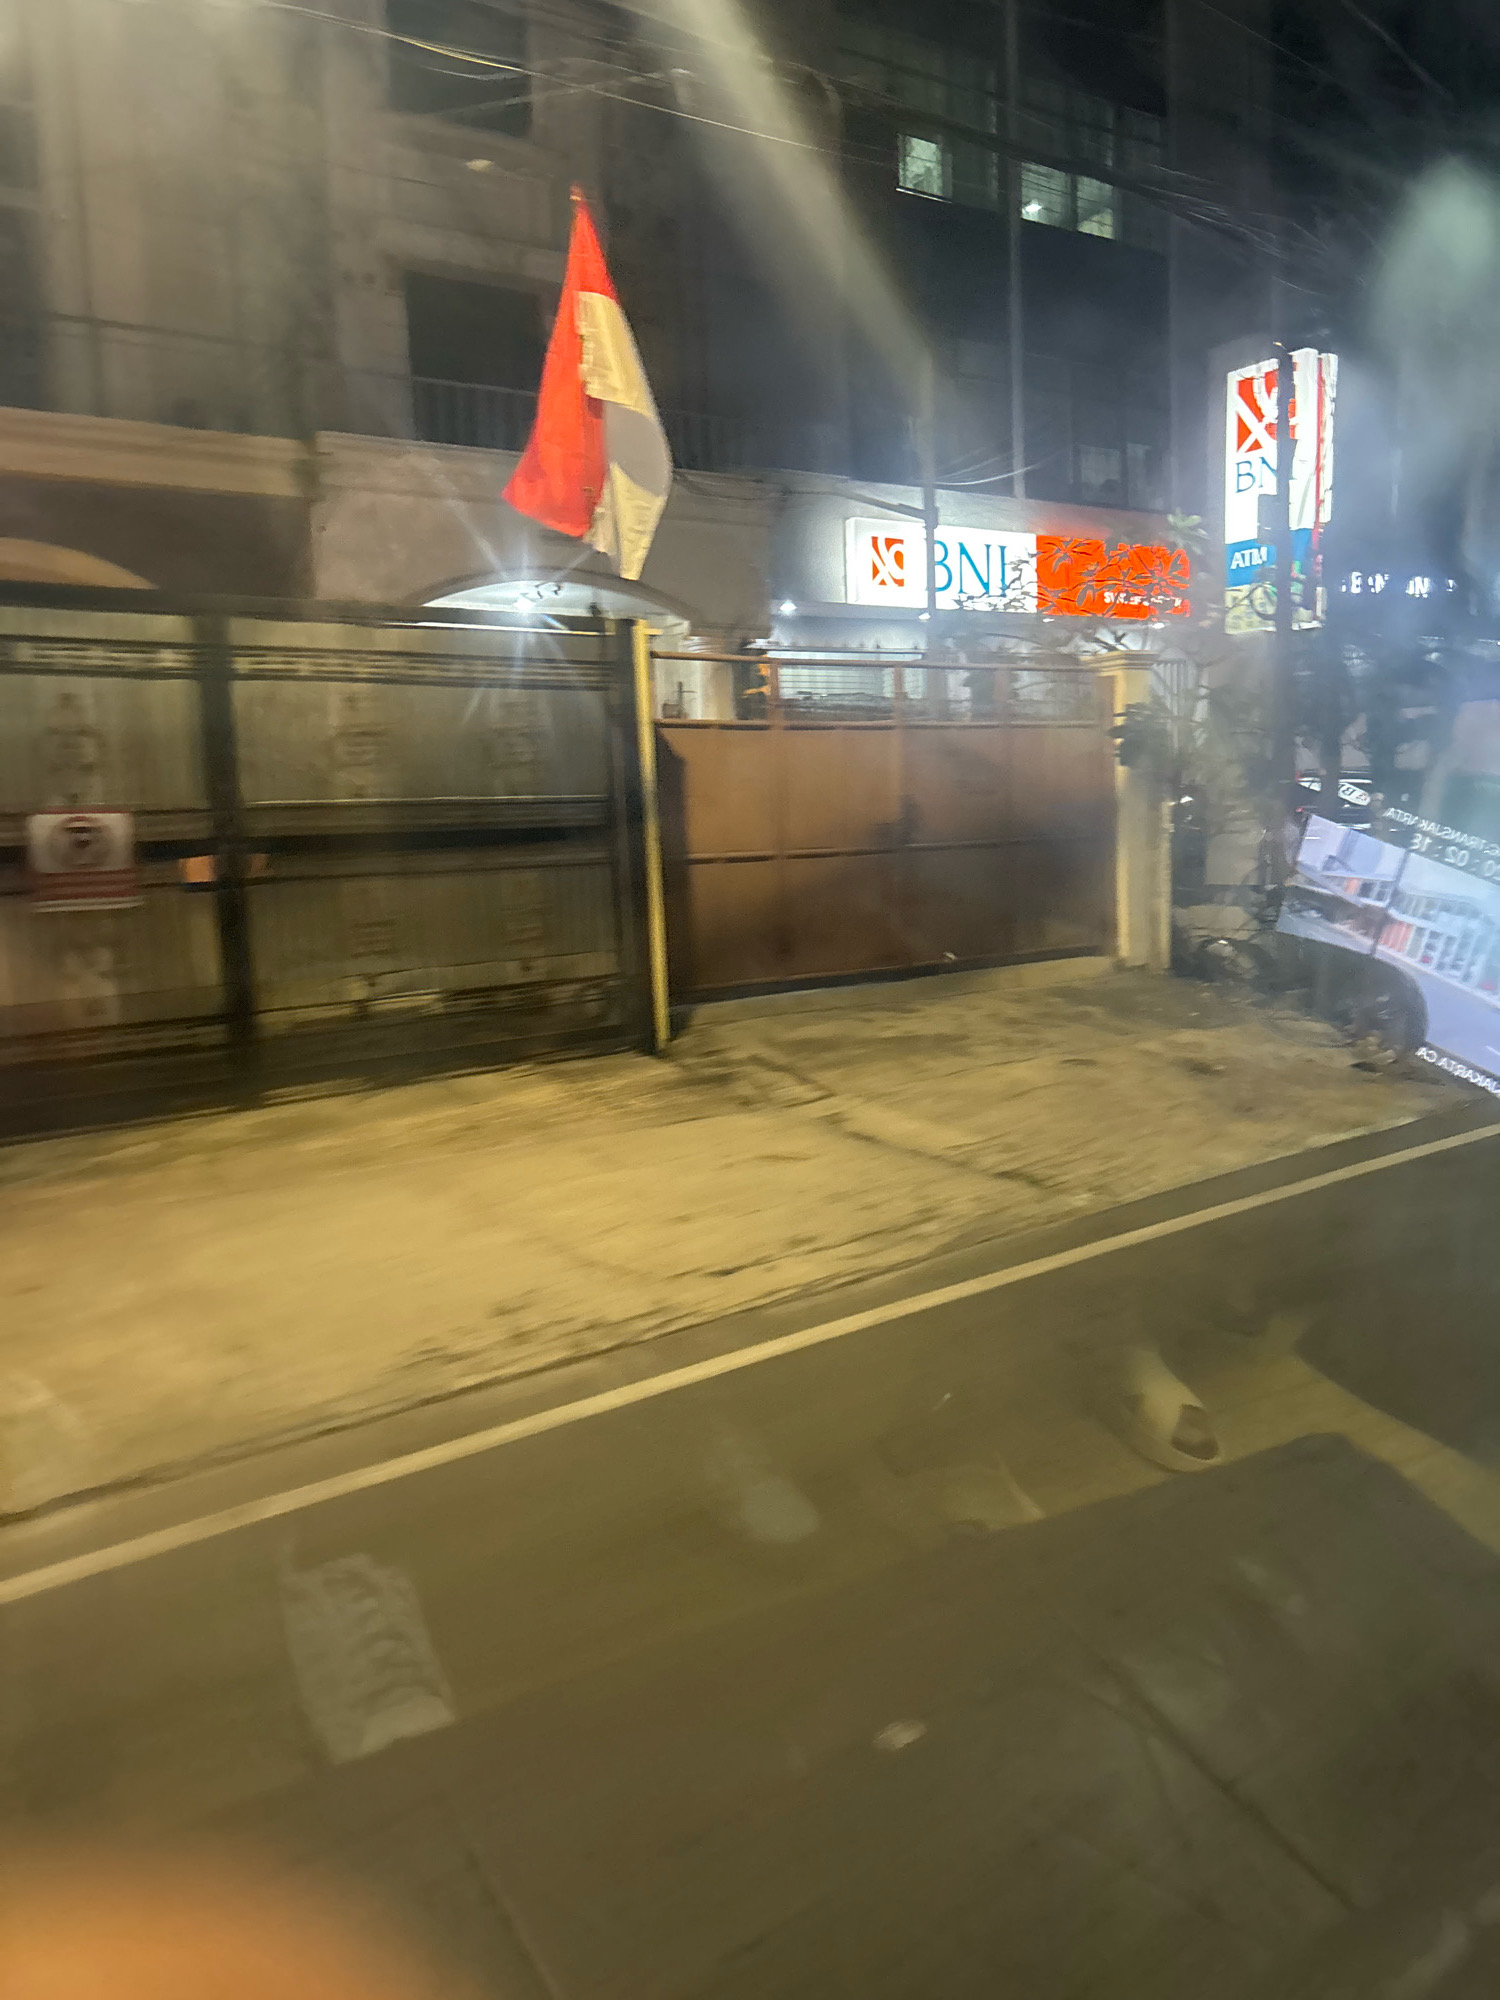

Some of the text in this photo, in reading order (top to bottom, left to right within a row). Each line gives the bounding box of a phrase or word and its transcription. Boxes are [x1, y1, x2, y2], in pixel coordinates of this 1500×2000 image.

[1235, 457, 1277, 493] BN
[934, 540, 1007, 597] BNI
[1230, 547, 1268, 569] ATM
